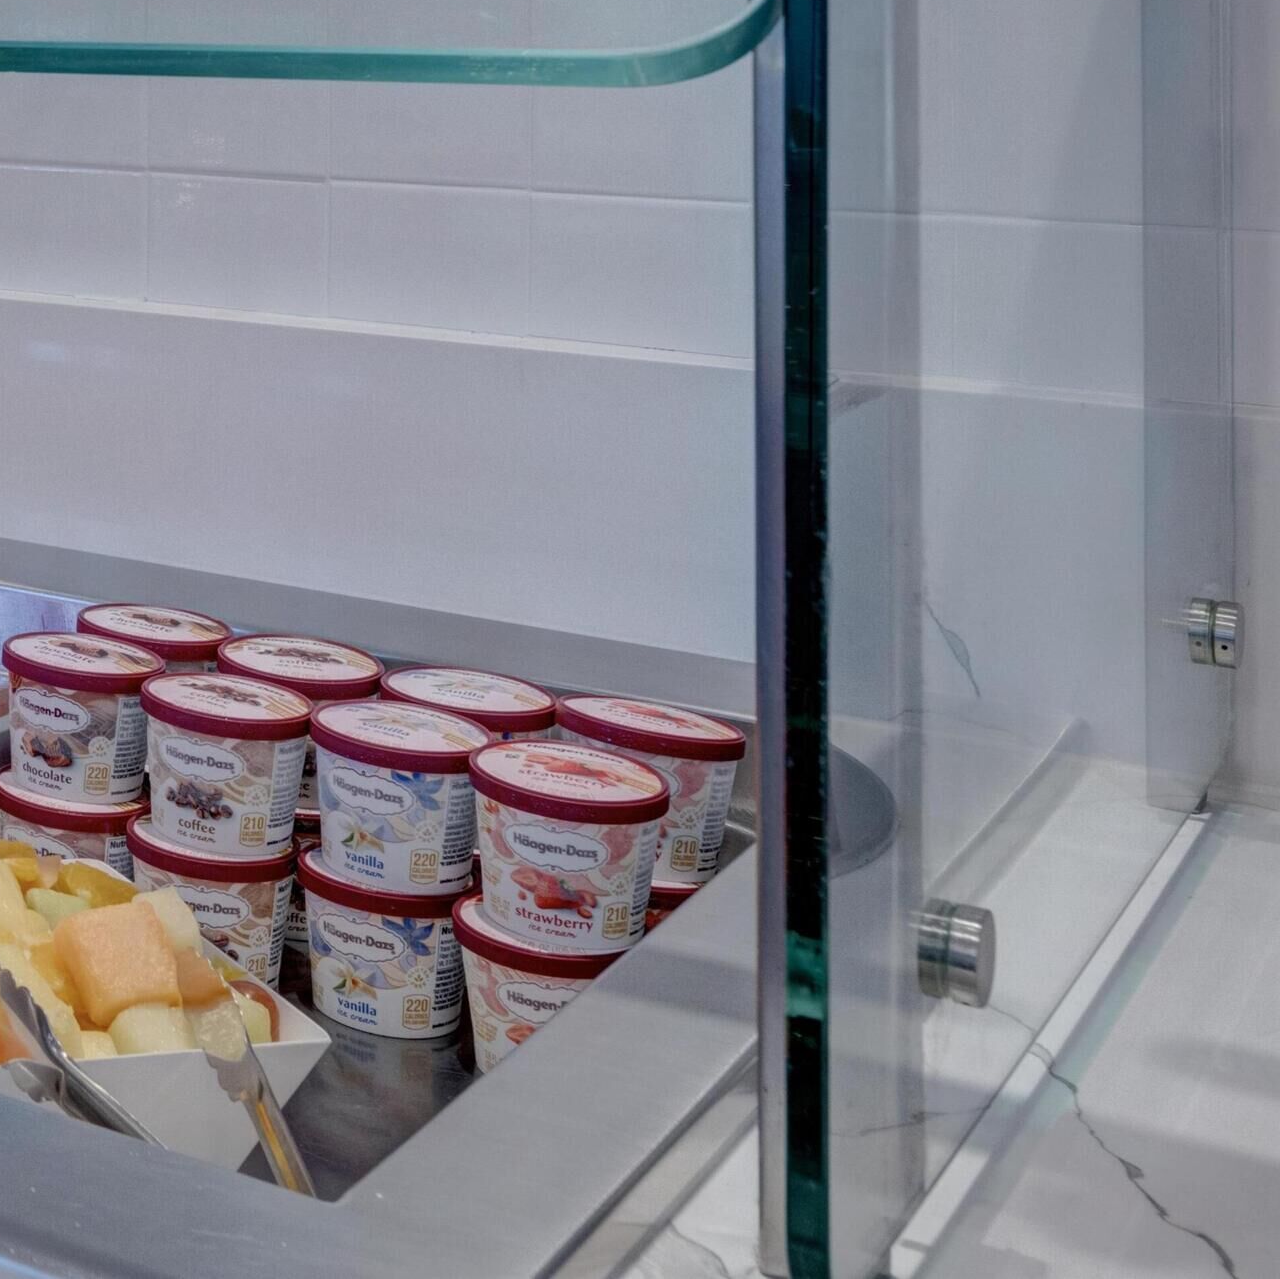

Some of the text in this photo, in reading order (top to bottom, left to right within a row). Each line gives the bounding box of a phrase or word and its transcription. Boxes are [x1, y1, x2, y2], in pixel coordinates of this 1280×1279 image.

[165, 743, 235, 770] Häagen-Dazs
[22, 761, 73, 785] chocolate
[87, 766, 108, 780] 220
[38, 780, 63, 791] cream
[333, 774, 405, 804] Häagen-Dazs
[178, 817, 216, 835] coffee
[243, 816, 265, 830] 210
[176, 829, 217, 843] ice cream
[513, 831, 599, 859] Häagen-Dazs
[675, 839, 698, 854] 210
[344, 850, 385, 870] vanilla
[413, 853, 436, 867] 220
[344, 862, 385, 879] ice cream
[515, 905, 594, 932] strawberry
[606, 906, 627, 921] 210
[323, 921, 396, 951] Häagen-Dazs
[528, 923, 577, 939] ice cream
[247, 956, 265, 972] 210
[338, 997, 377, 1016] vanilla
[406, 999, 429, 1012] 220
[336, 1008, 378, 1026] ice cream
